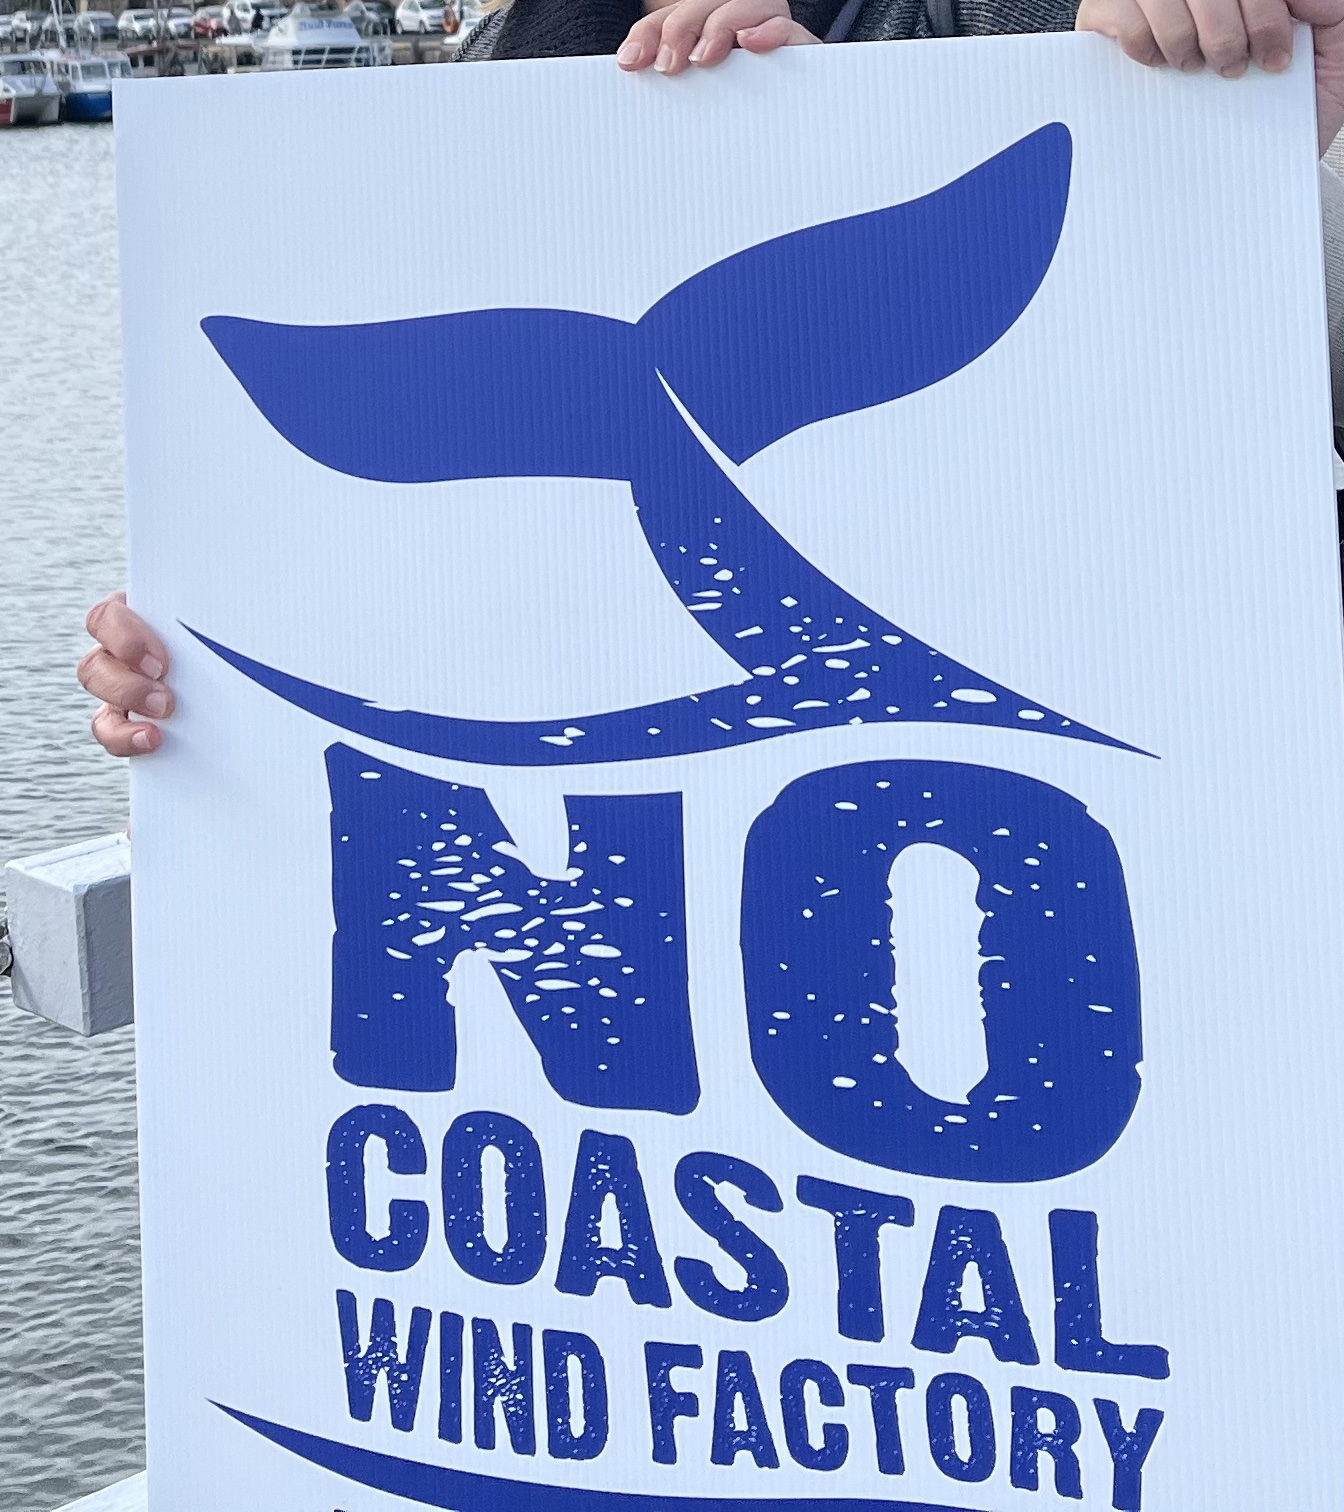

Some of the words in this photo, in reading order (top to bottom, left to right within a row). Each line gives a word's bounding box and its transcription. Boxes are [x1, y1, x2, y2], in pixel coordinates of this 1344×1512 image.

[324, 742, 1142, 1182] NO
[326, 1104, 1169, 1379] COASTAL
[337, 1290, 608, 1460] WIND
[645, 1342, 1164, 1512] FACTORY
